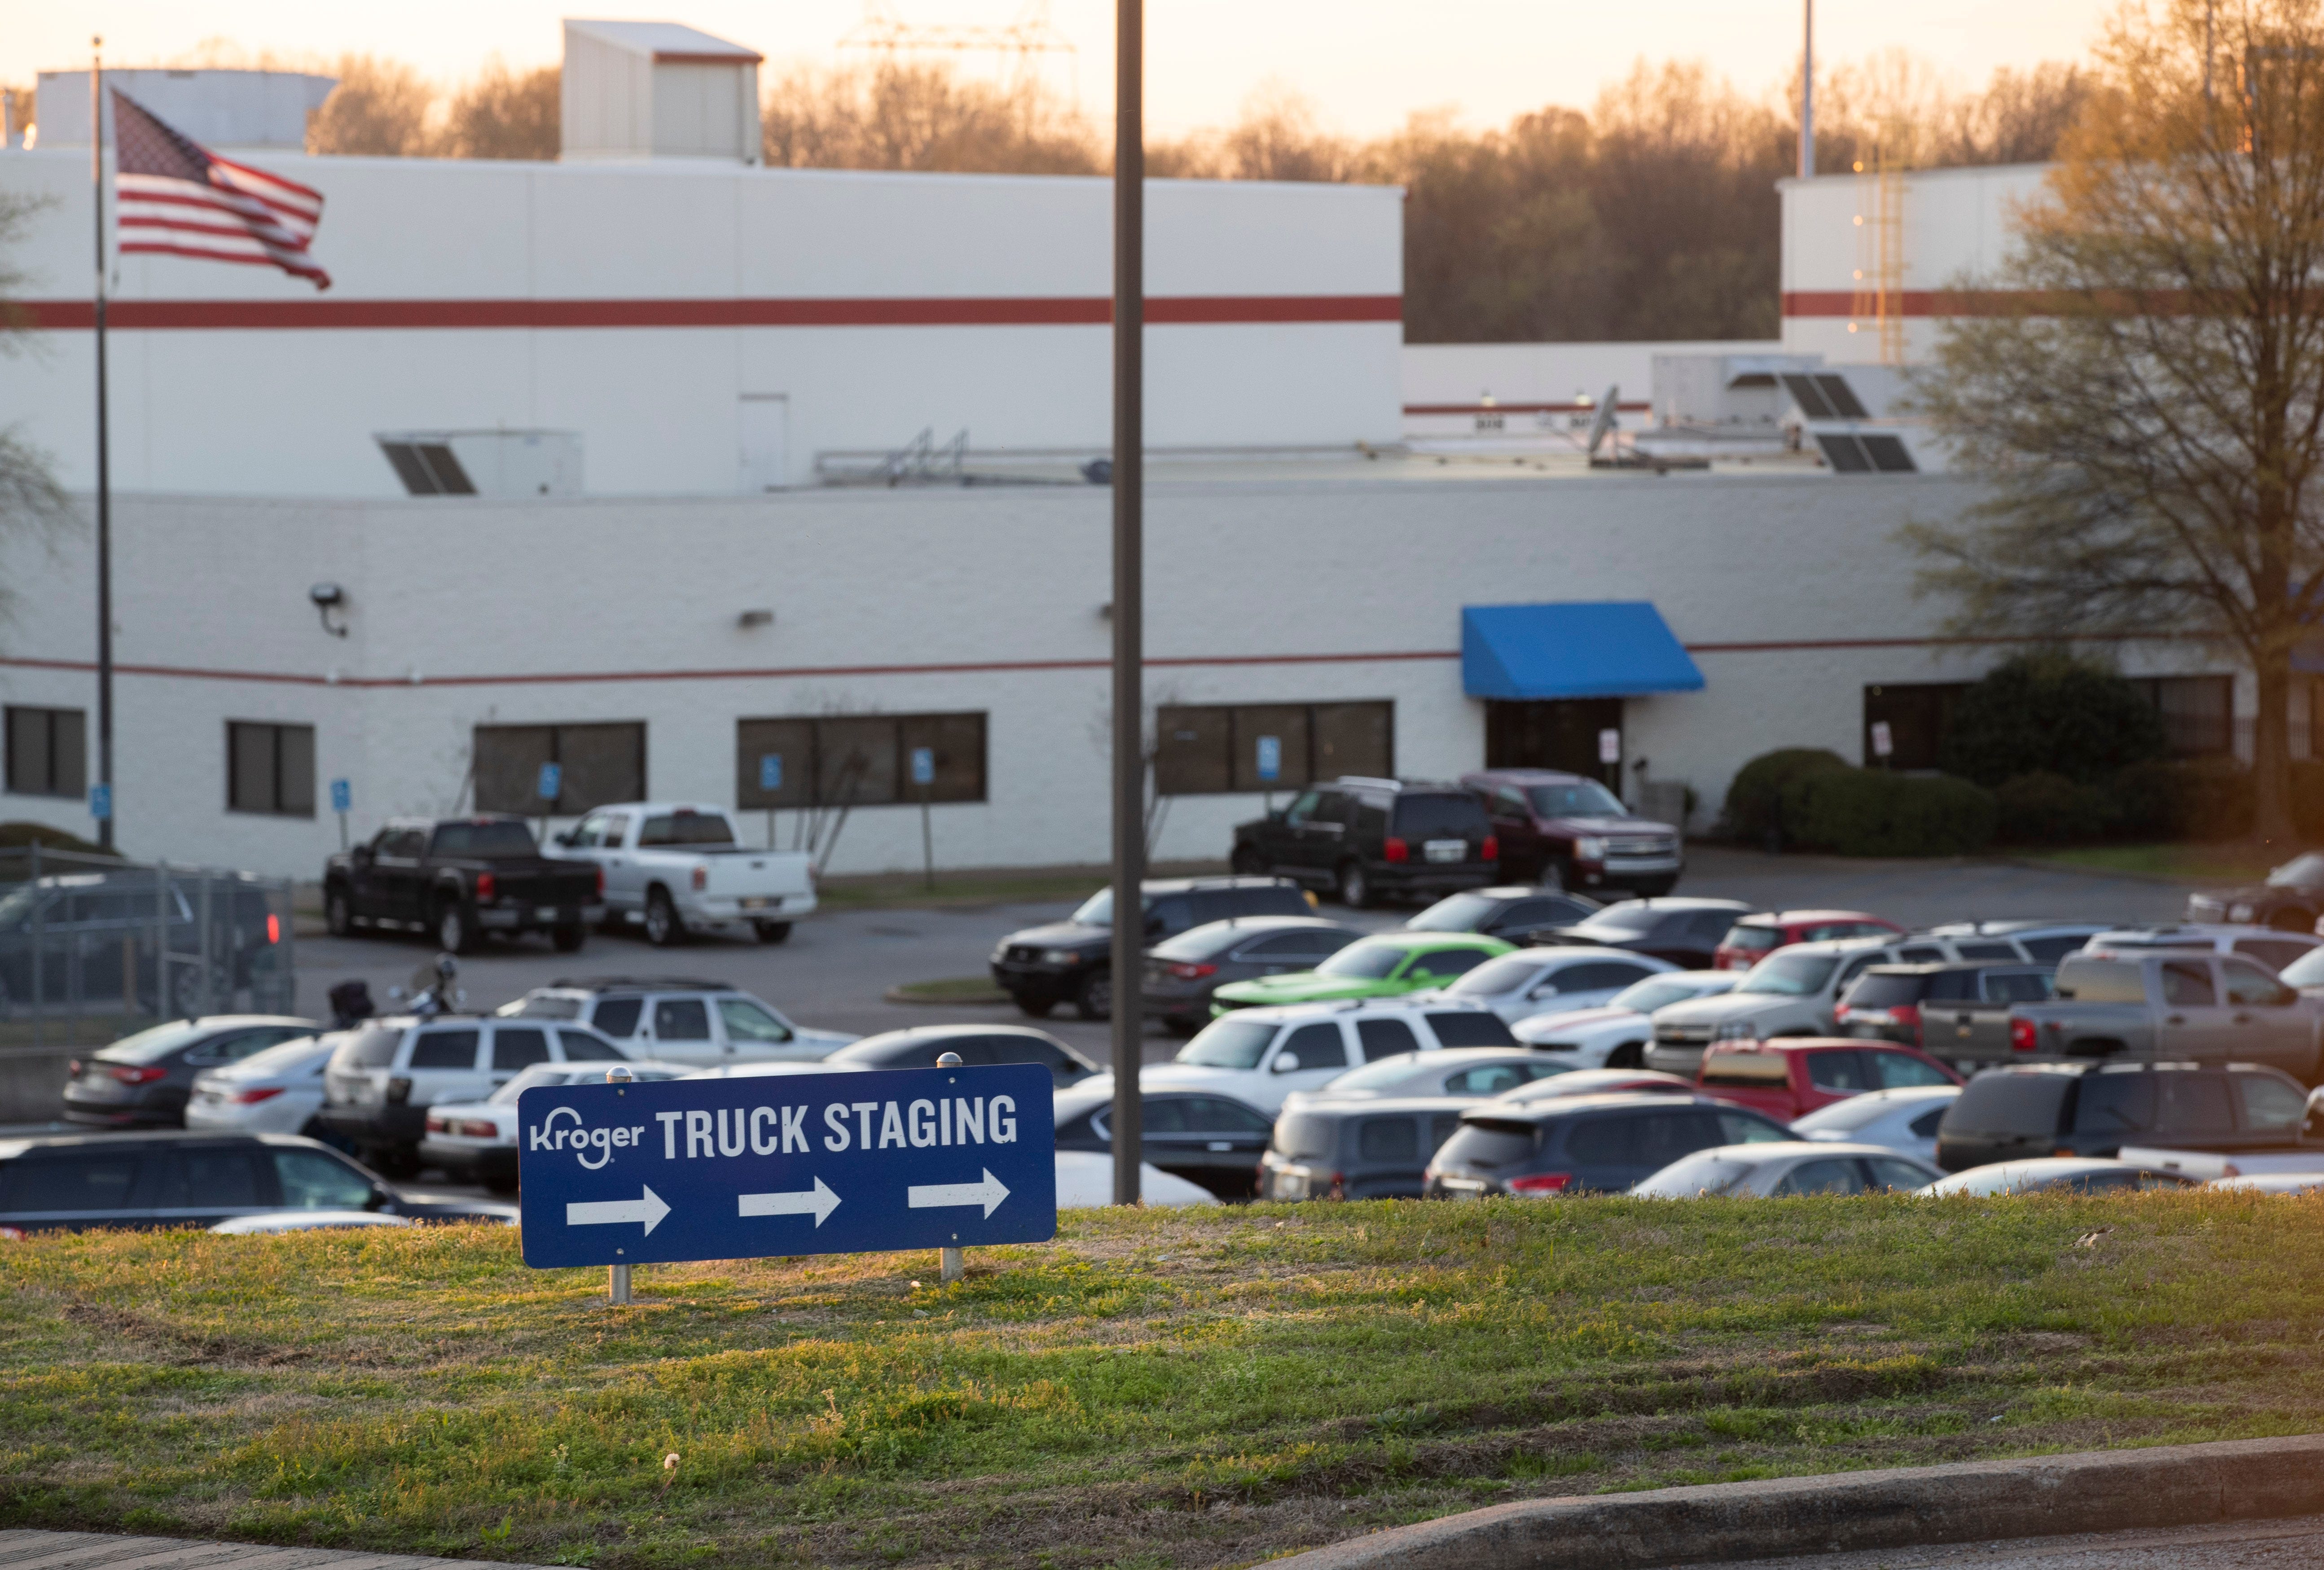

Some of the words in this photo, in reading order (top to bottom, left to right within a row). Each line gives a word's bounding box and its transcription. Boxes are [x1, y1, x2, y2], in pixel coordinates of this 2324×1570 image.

[530, 1106, 645, 1170] Kroger
[655, 1105, 810, 1159] TRUCK
[823, 1095, 1017, 1152] STAGING
